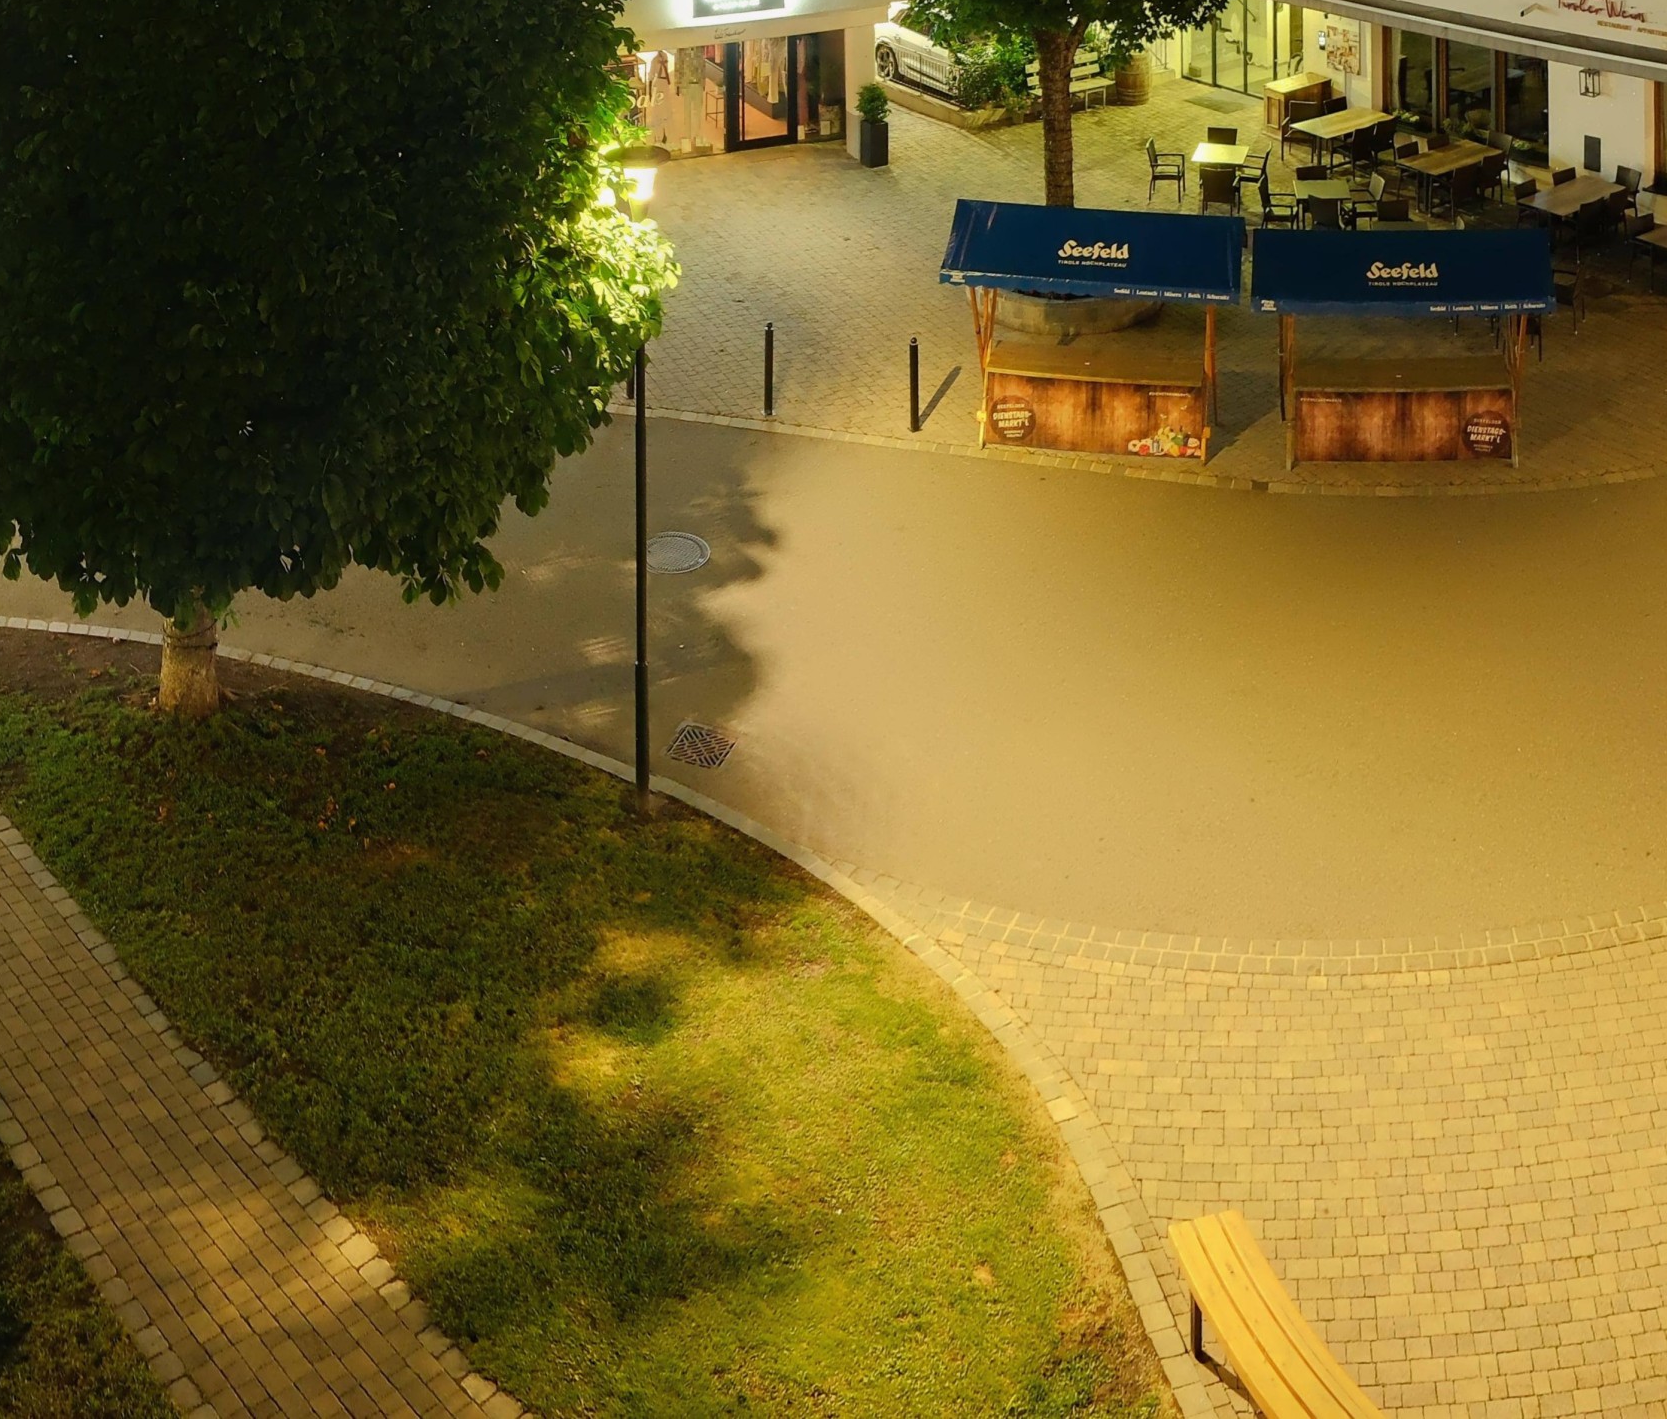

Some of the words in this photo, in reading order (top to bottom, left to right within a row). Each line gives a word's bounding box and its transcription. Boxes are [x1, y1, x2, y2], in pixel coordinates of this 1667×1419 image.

[1057, 239, 1130, 260] Seefeld
[1058, 259, 1080, 267] TIROLS
[1081, 261, 1128, 269] HOCHPLATEAU
[1366, 261, 1439, 280] Seefeld
